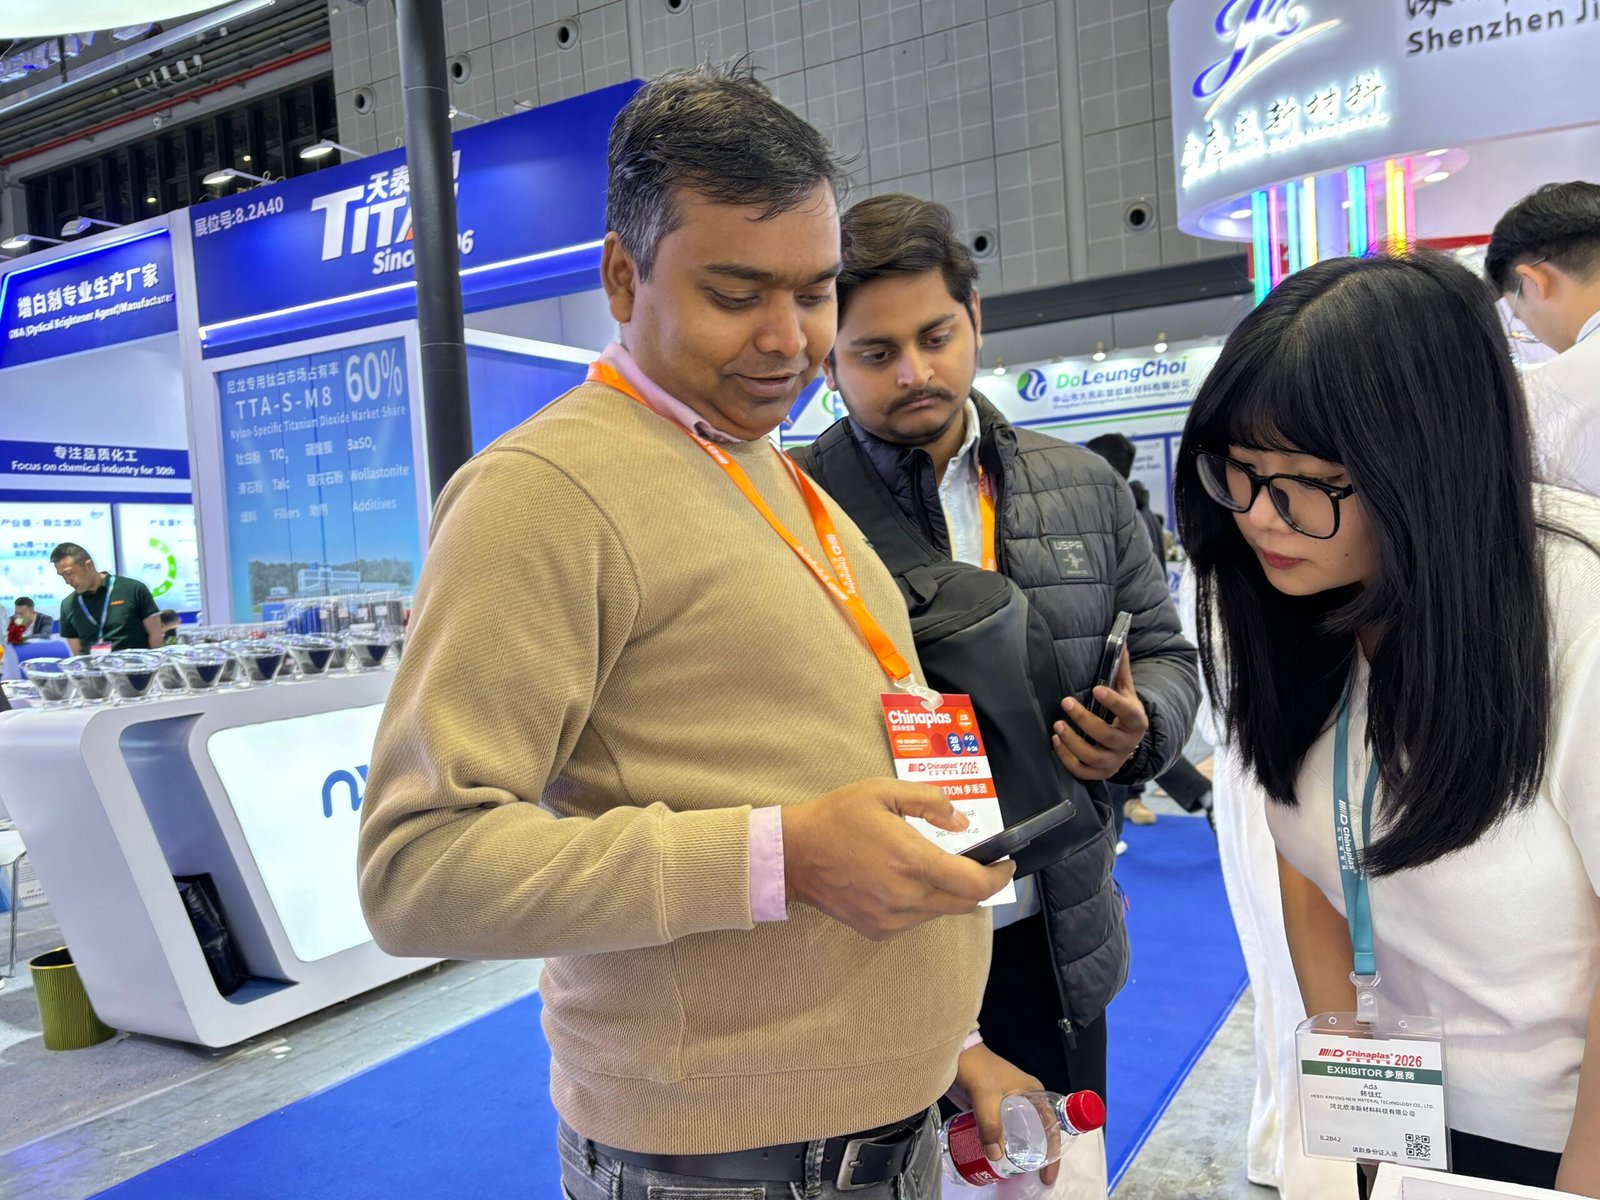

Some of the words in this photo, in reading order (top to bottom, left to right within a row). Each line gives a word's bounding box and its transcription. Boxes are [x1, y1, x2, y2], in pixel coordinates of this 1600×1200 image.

[1407, 9, 1564, 55] Shenzhen
[194, 196, 284, 237] 展位号:8.2A40
[372, 247, 416, 276] Sinc
[17, 262, 160, 319] 增白剂专业生产厂家
[226, 362, 339, 395] 尼龙专用钛白市场占有率
[346, 347, 403, 403] 60%
[1056, 356, 1188, 389] DoLeungChoi
[230, 421, 283, 442] Nylon-Specific
[284, 416, 318, 431] Titanium
[320, 411, 350, 427] Dioxide
[351, 407, 381, 422] Market
[382, 404, 406, 417] Share
[53, 445, 139, 463] 专注品质化工
[11, 460, 42, 471] Focus
[43, 463, 57, 471] on
[58, 462, 100, 474] chemical
[101, 463, 139, 477] industry
[140, 465, 153, 475] for
[351, 464, 409, 482] Wollastonite
[272, 478, 290, 491] Talc
[352, 498, 397, 513] Additives
[887, 708, 952, 729] Chinaplas
[1394, 1054, 1422, 1068] 2026
[1327, 1065, 1383, 1078] EXHIBITOR
[1384, 1069, 1415, 1081] 参展商
[1380, 1100, 1412, 1108] TECHNOLOGY
